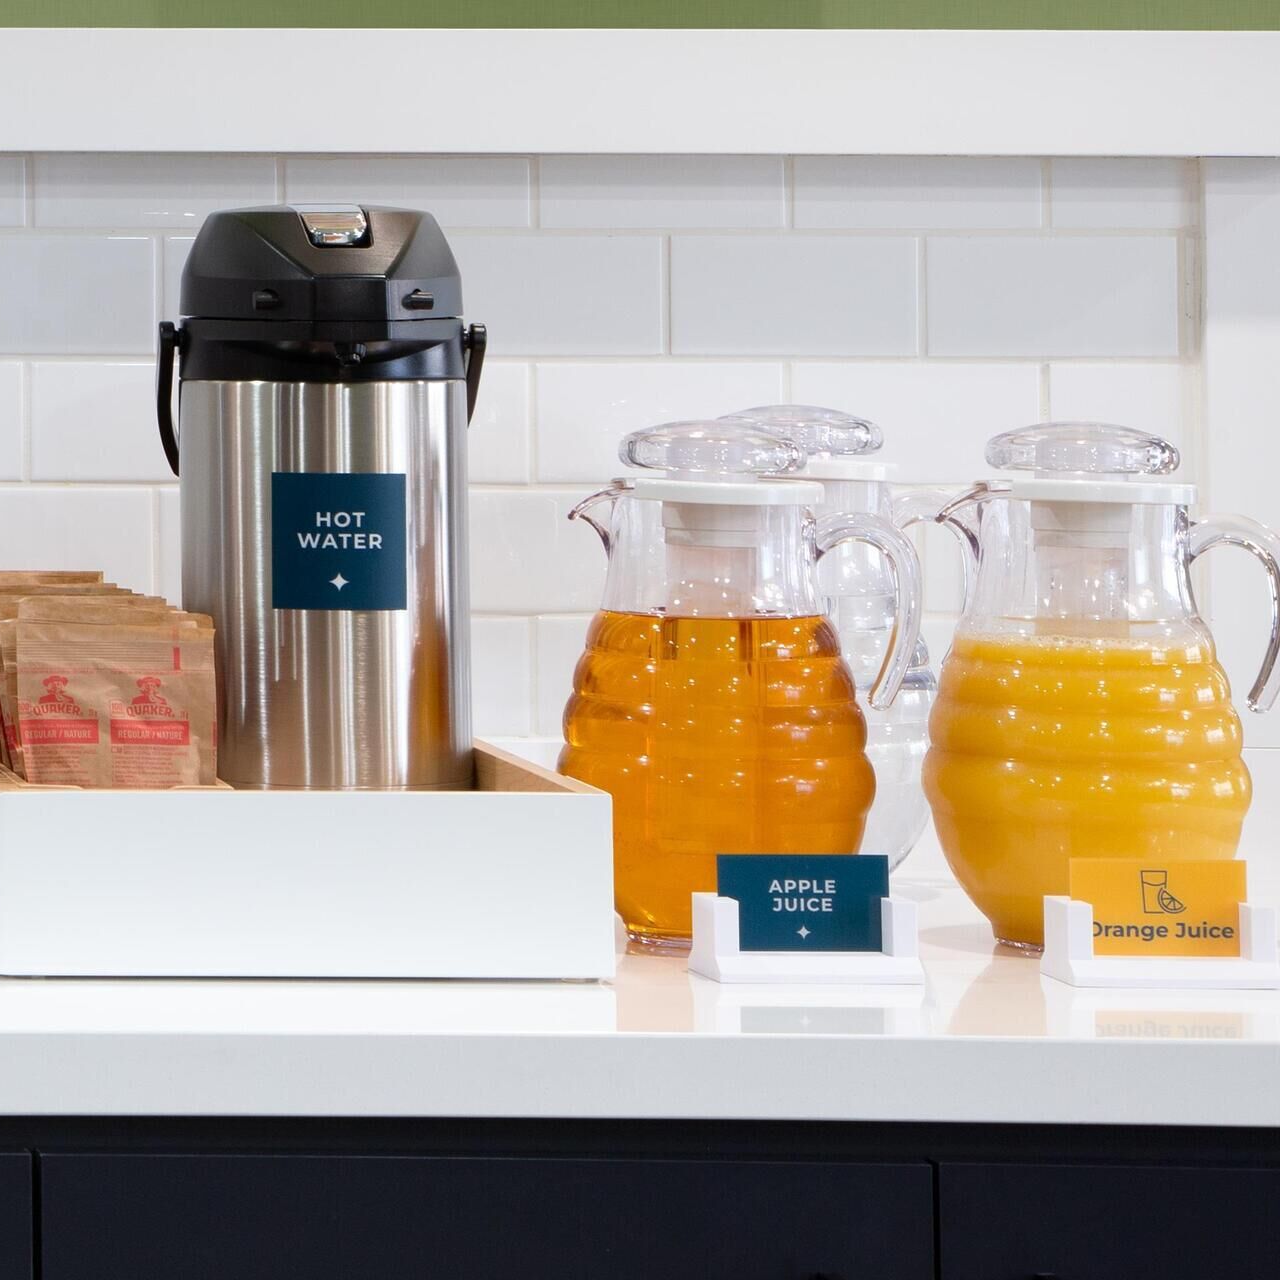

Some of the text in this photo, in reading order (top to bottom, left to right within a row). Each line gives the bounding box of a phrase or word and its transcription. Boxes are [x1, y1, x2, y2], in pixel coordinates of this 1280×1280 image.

[316, 511, 366, 528] HOT
[297, 532, 383, 550] WATER
[33, 703, 81, 716] QUAKER
[126, 704, 173, 717] QUAKER
[768, 879, 836, 894] APPLE
[772, 897, 833, 912] JUICE
[1175, 921, 1234, 939] Juice
